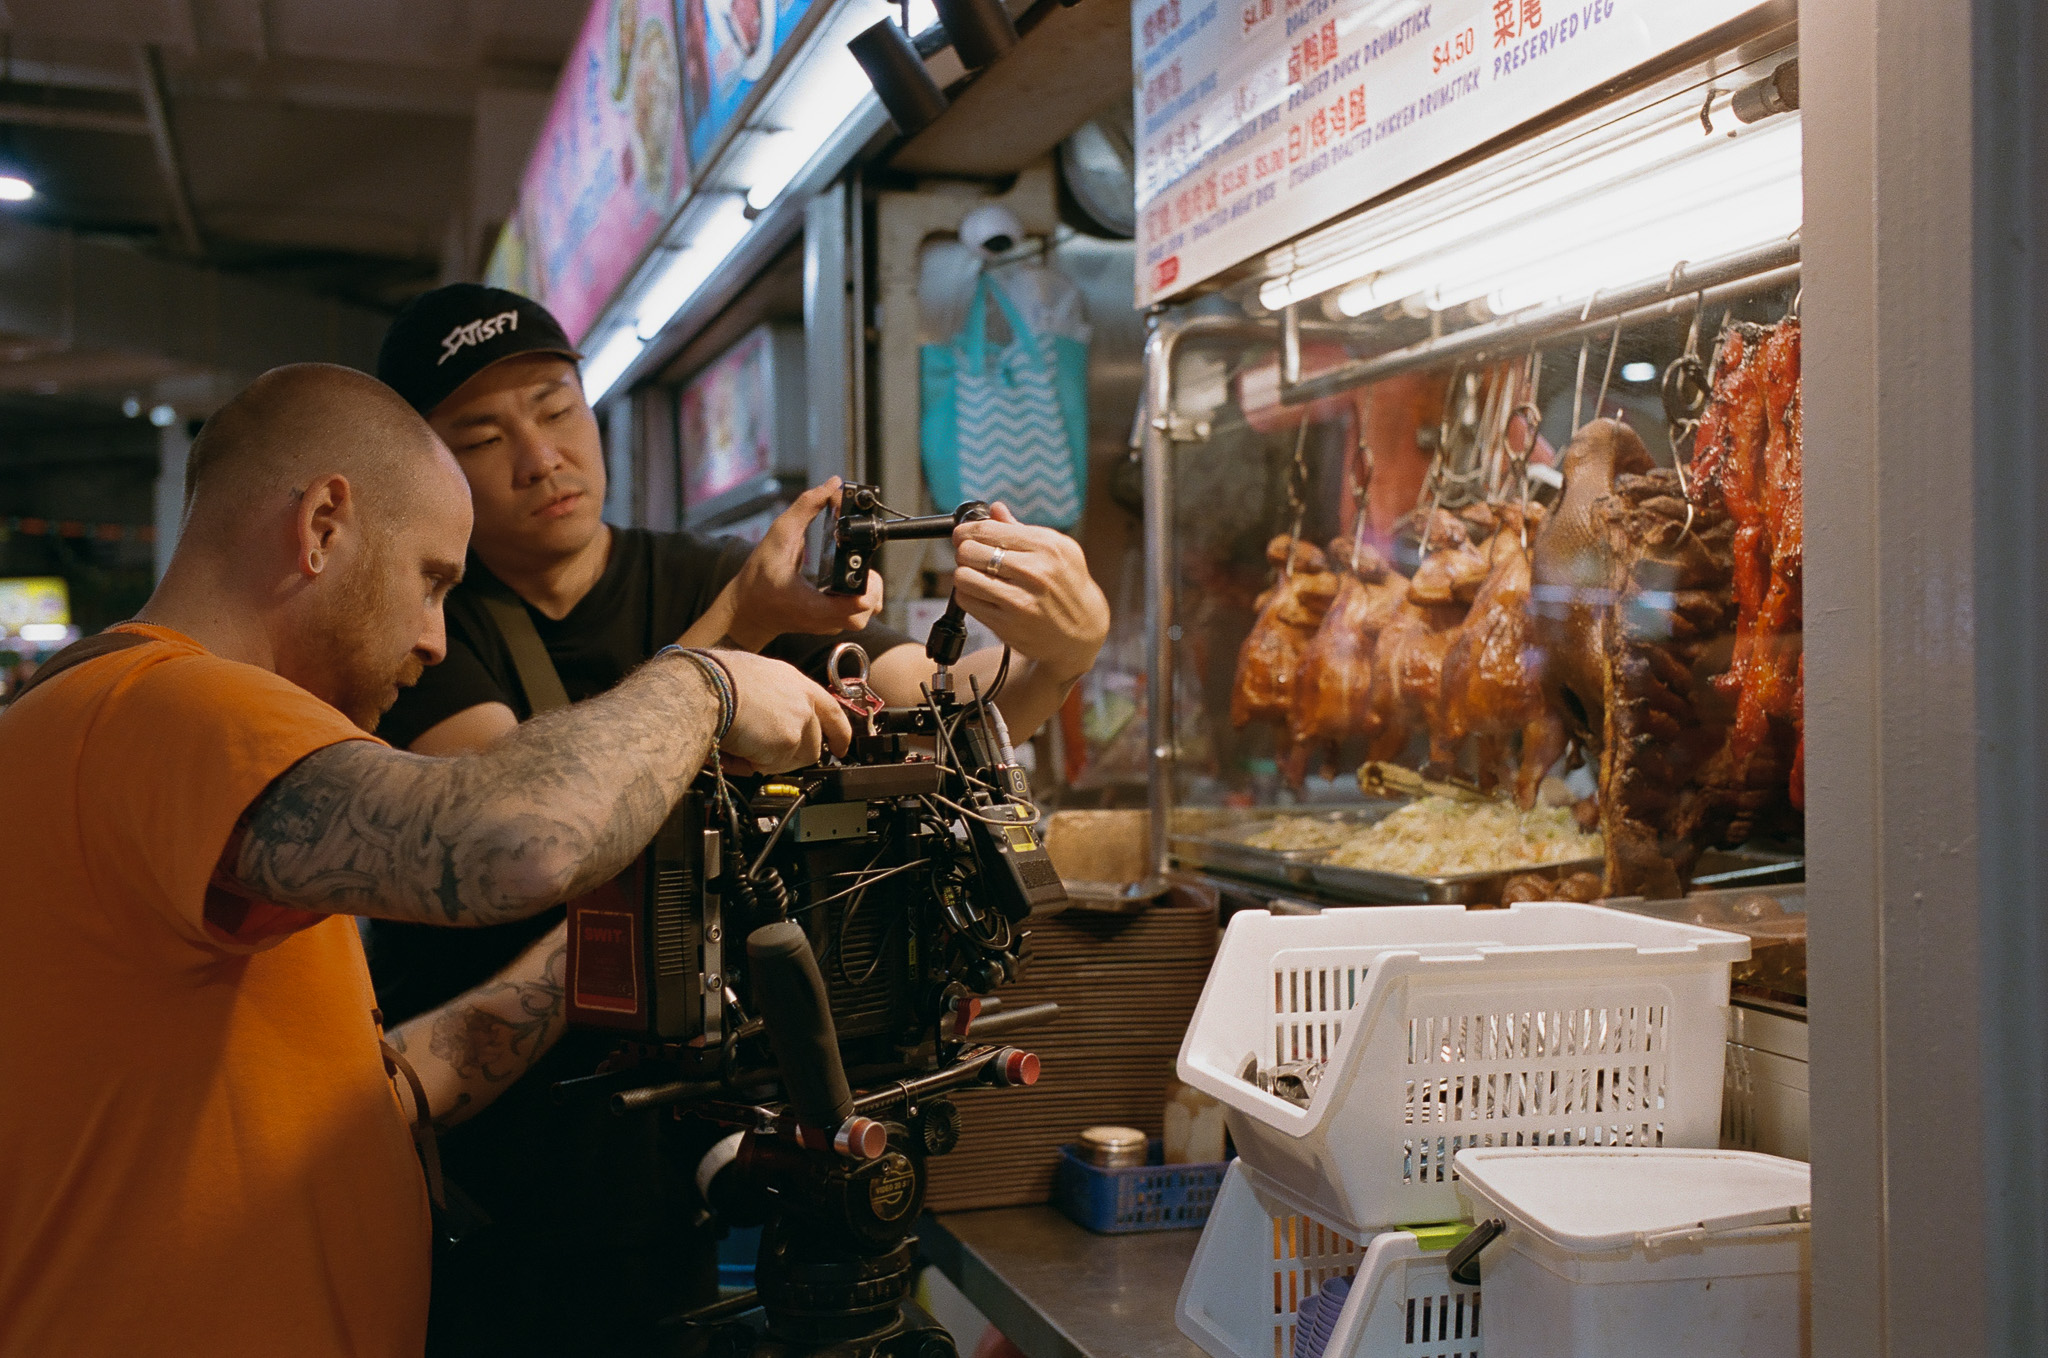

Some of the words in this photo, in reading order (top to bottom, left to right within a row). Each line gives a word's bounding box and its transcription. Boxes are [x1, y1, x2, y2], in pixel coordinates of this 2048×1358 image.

[1333, 49, 1361, 84] DUCK
[1363, 4, 1432, 65] DRUMSTICK
[1432, 27, 1474, 75] $4.50
[1493, 12, 1579, 81] PRESERVED
[1582, 0, 1614, 31] VEG
[1375, 103, 1416, 142] CHICKEN
[1418, 66, 1480, 119] DRUMSTICK
[437, 309, 519, 366] SATISFY
